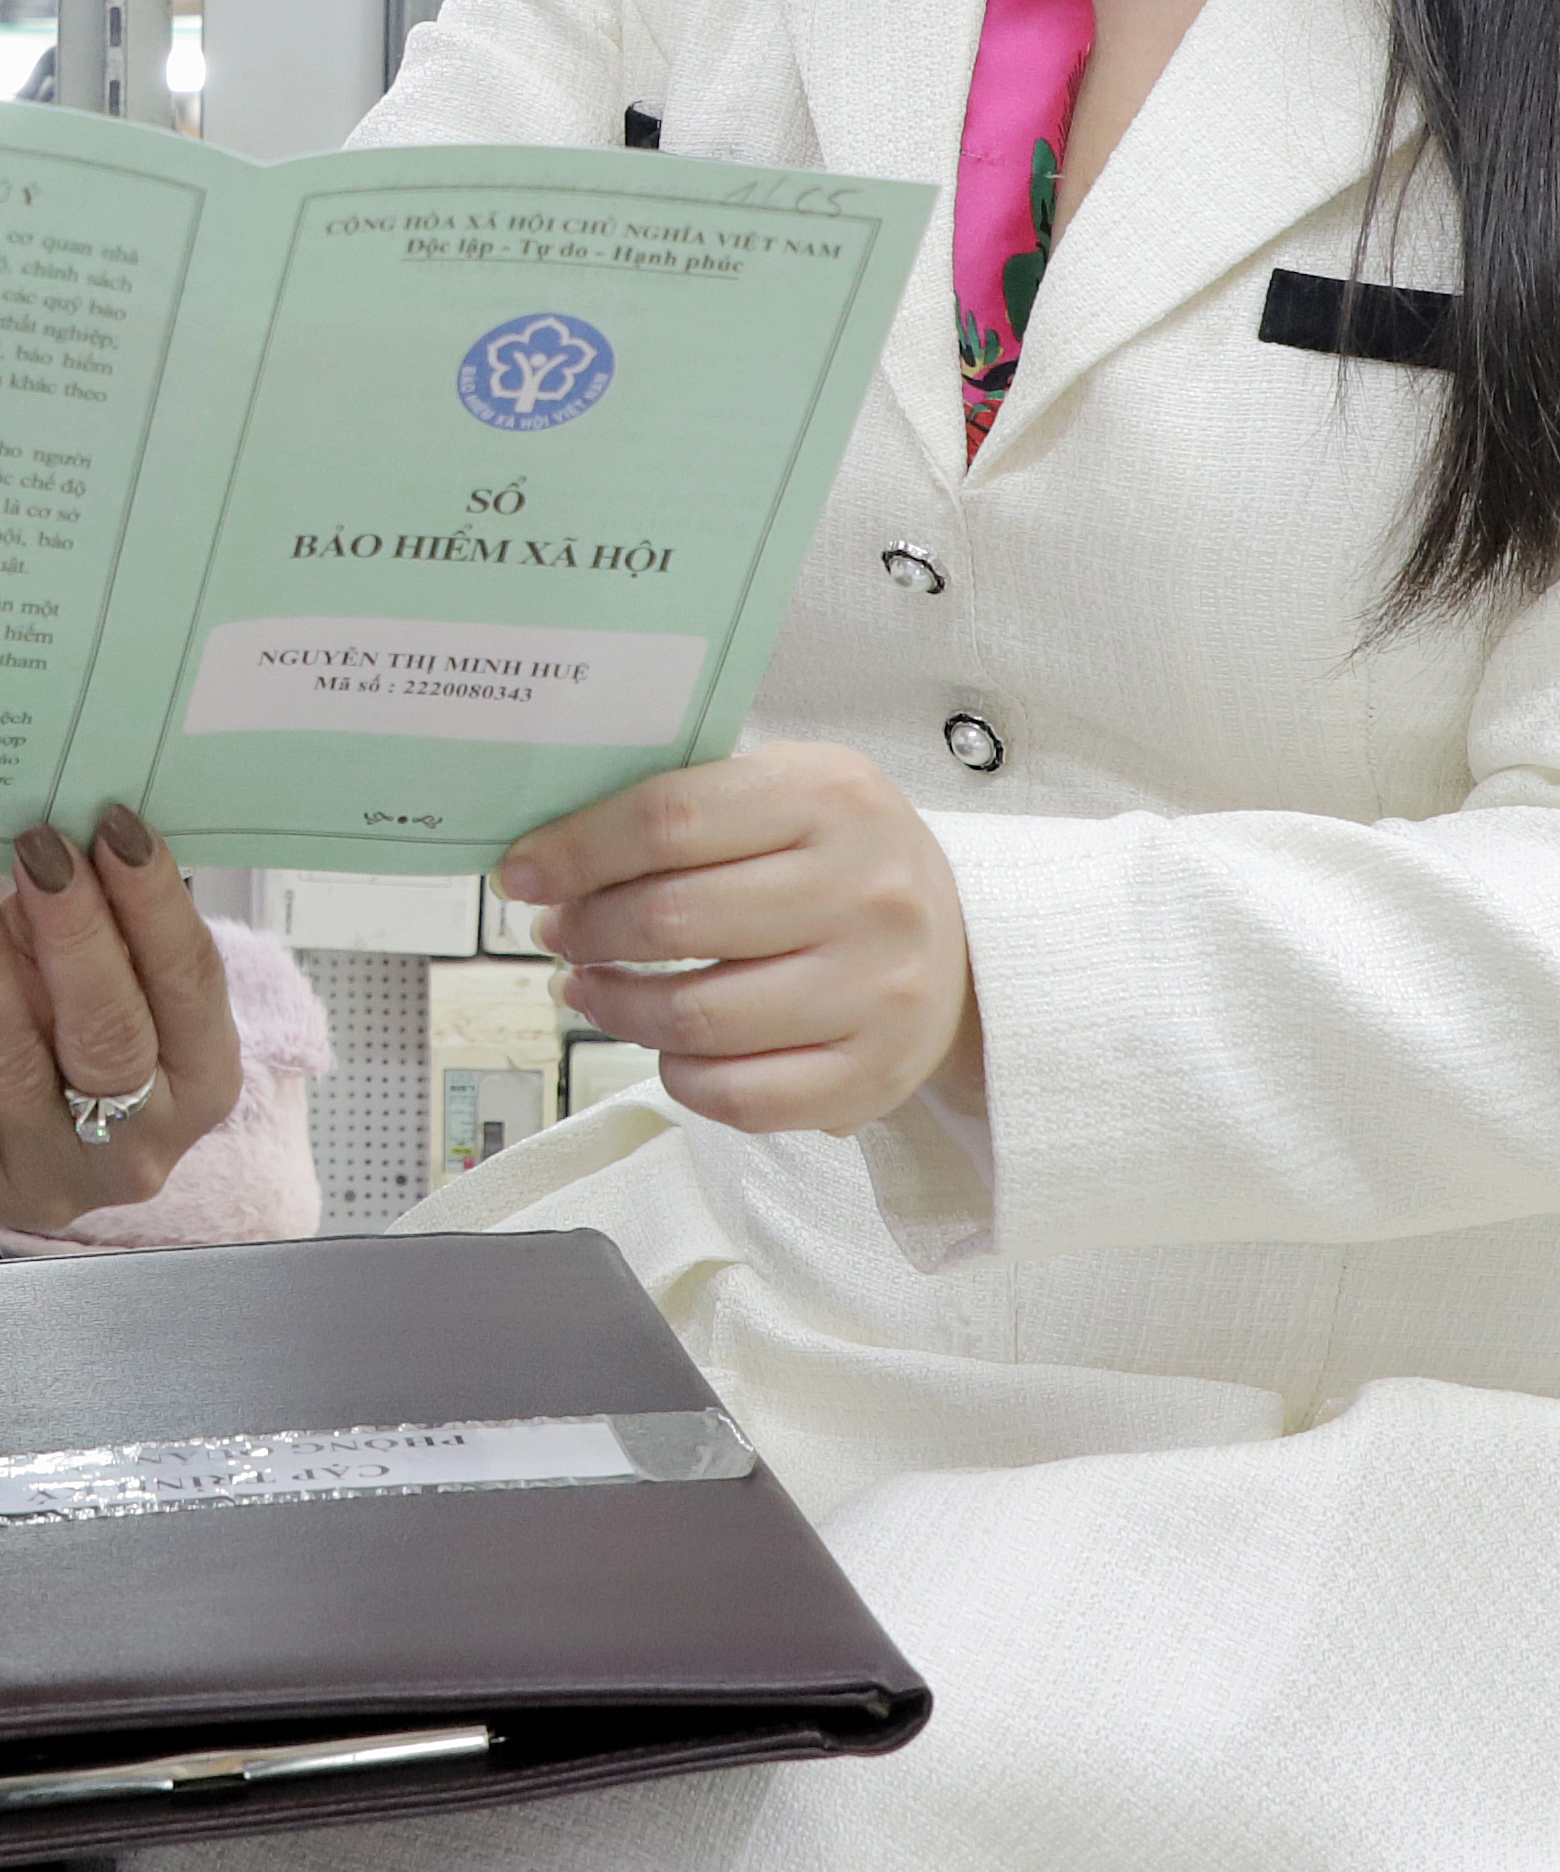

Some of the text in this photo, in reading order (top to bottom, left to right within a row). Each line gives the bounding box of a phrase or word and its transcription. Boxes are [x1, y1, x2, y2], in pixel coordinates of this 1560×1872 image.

[325, 210, 396, 237] CỘNG
[404, 209, 457, 230] HÒA
[466, 210, 498, 231] XÃ
[507, 210, 558, 236] HỘI
[716, 225, 778, 253] VIỆT
[785, 237, 844, 260] NAM
[404, 237, 451, 258] Độc
[457, 238, 494, 261] lập
[520, 240, 553, 263] Tự
[559, 242, 589, 259] do
[612, 244, 678, 271] Hạnh
[684, 250, 744, 276] phúc
[465, 475, 528, 516] SỔ
[289, 523, 676, 579] BẢO HIỂM XÃ HỘI
[258, 646, 590, 686] NGUYỄN THỊ MINH HUỆ
[313, 675, 351, 692] Mã
[357, 673, 381, 694] số
[403, 678, 533, 703] 2220080343
[291, 1435, 466, 1455] PHÒNG
